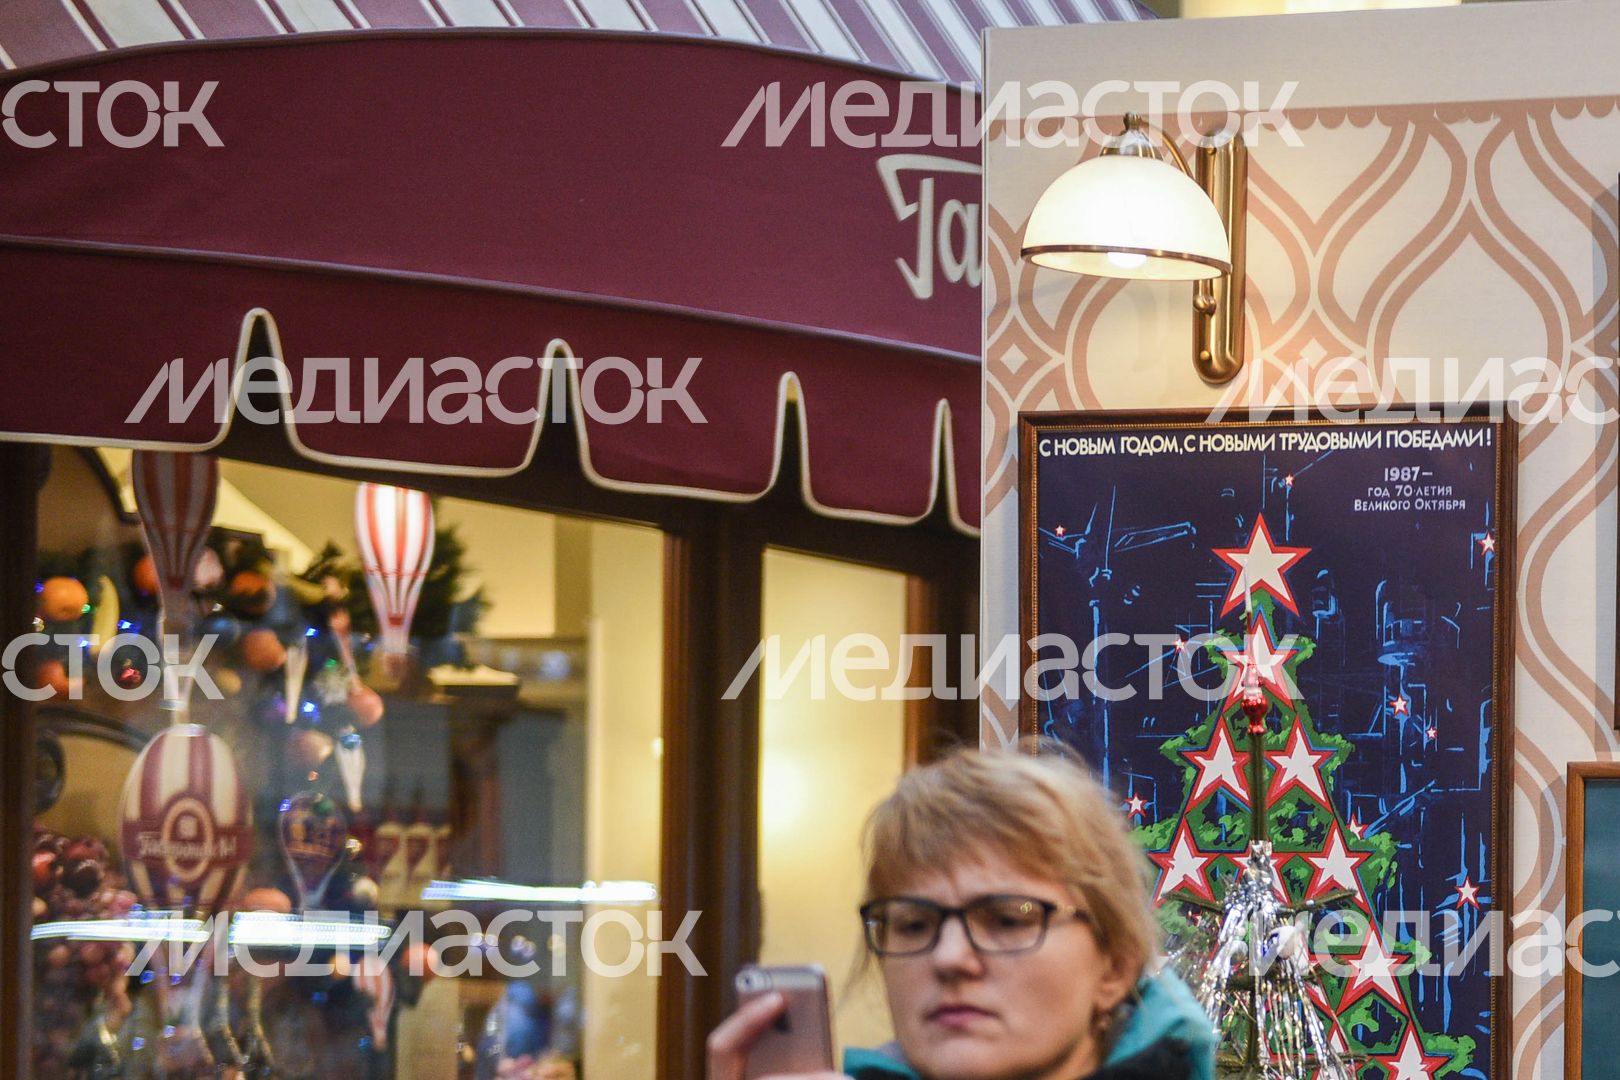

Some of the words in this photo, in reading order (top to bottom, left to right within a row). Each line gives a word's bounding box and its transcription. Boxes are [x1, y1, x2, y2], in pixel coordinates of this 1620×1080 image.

[1039, 439, 1051, 457] С
[1055, 437, 1115, 456] НОВЫМ
[1120, 434, 1183, 455] ГОДОМ,
[1184, 435, 1196, 453] С
[1199, 432, 1276, 453] НОВЫМИ
[1279, 430, 1381, 452] ТРУДОВЫМИ
[1386, 428, 1493, 450] ПОБЕДАМИ!
